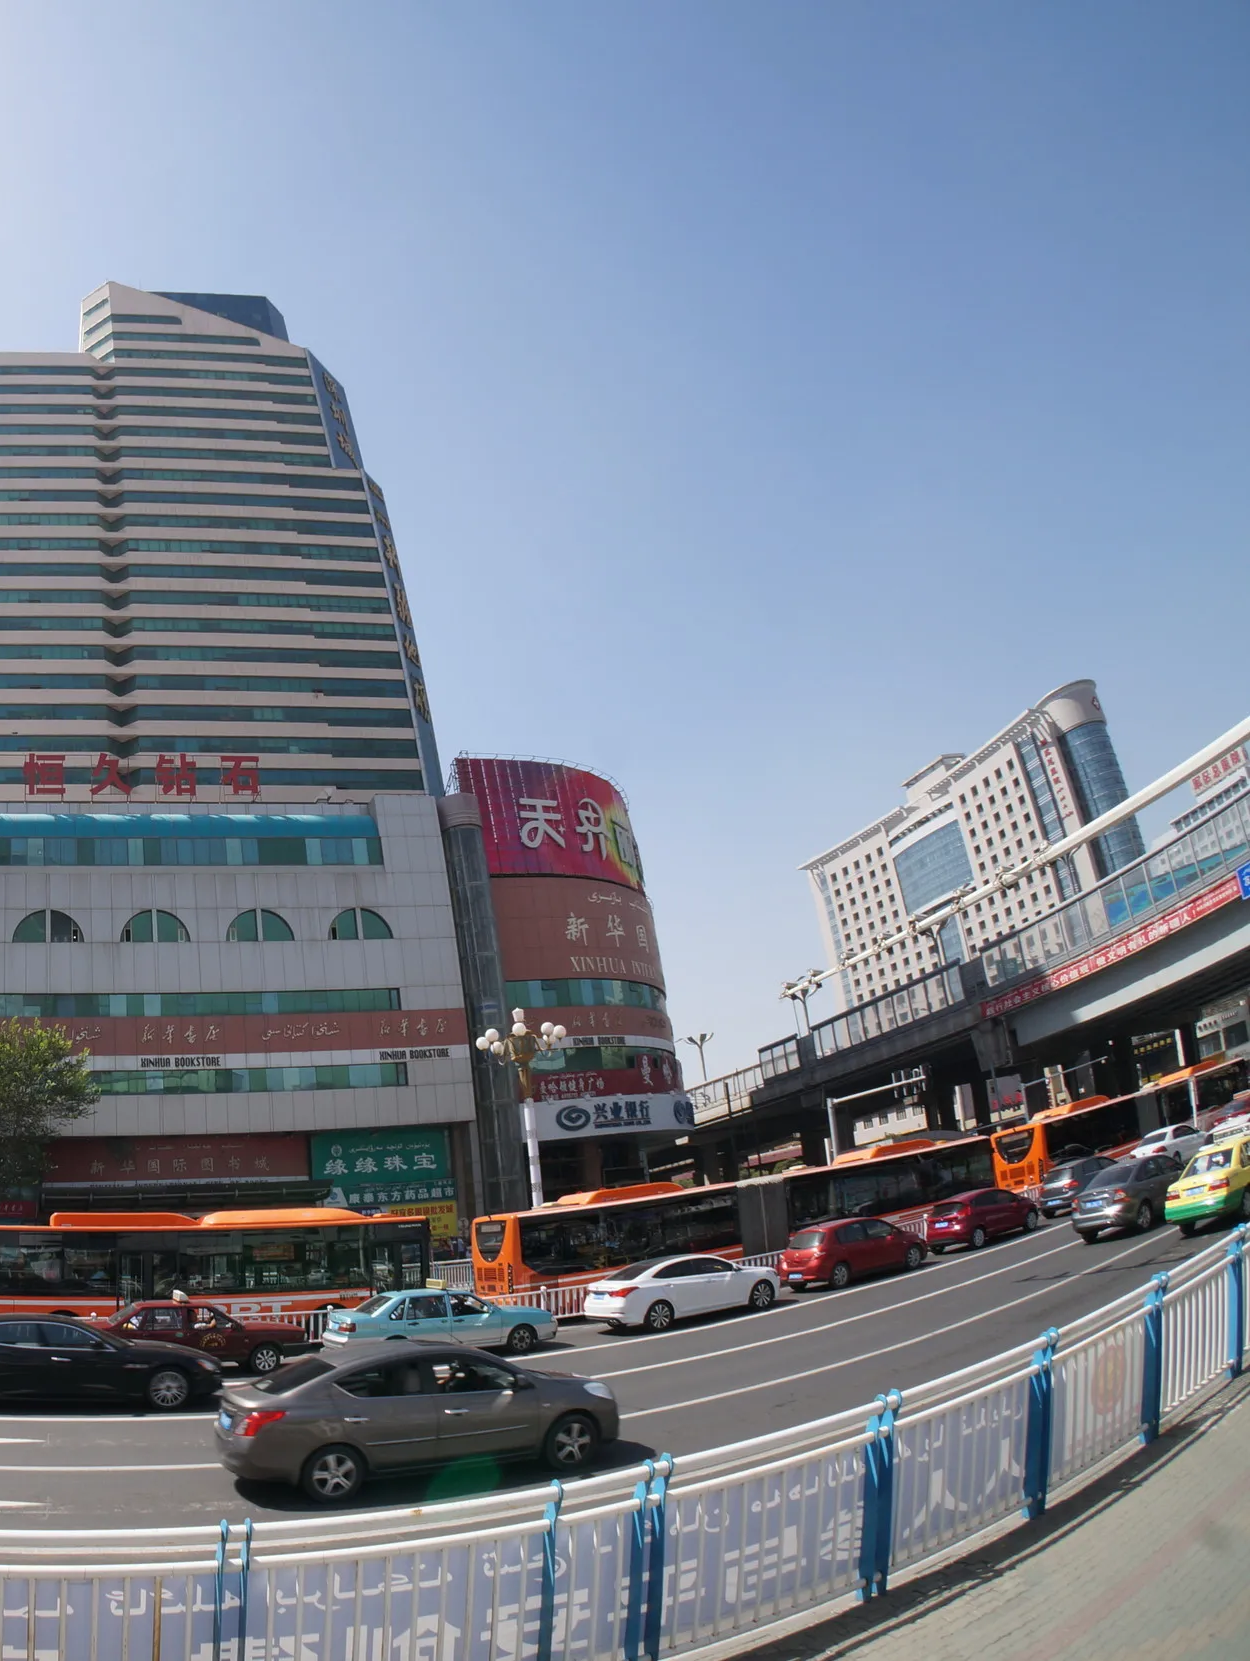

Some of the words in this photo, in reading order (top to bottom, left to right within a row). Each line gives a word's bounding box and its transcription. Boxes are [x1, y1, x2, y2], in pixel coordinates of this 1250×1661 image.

[22, 753, 260, 796] 恒久钻石
[570, 956, 628, 975] XINHUA
[140, 1057, 171, 1068] XINHUA
[174, 1056, 221, 1067] BOOKSTORE
[379, 1050, 407, 1061] XINHUA
[409, 1048, 450, 1060] BOOKSTORE
[593, 1100, 650, 1123] 兴业银行
[90, 1154, 271, 1177] 新华国际图书城
[323, 1153, 438, 1176] 缘缘珠宝
[349, 1186, 456, 1204] 康泰东方药品超市
